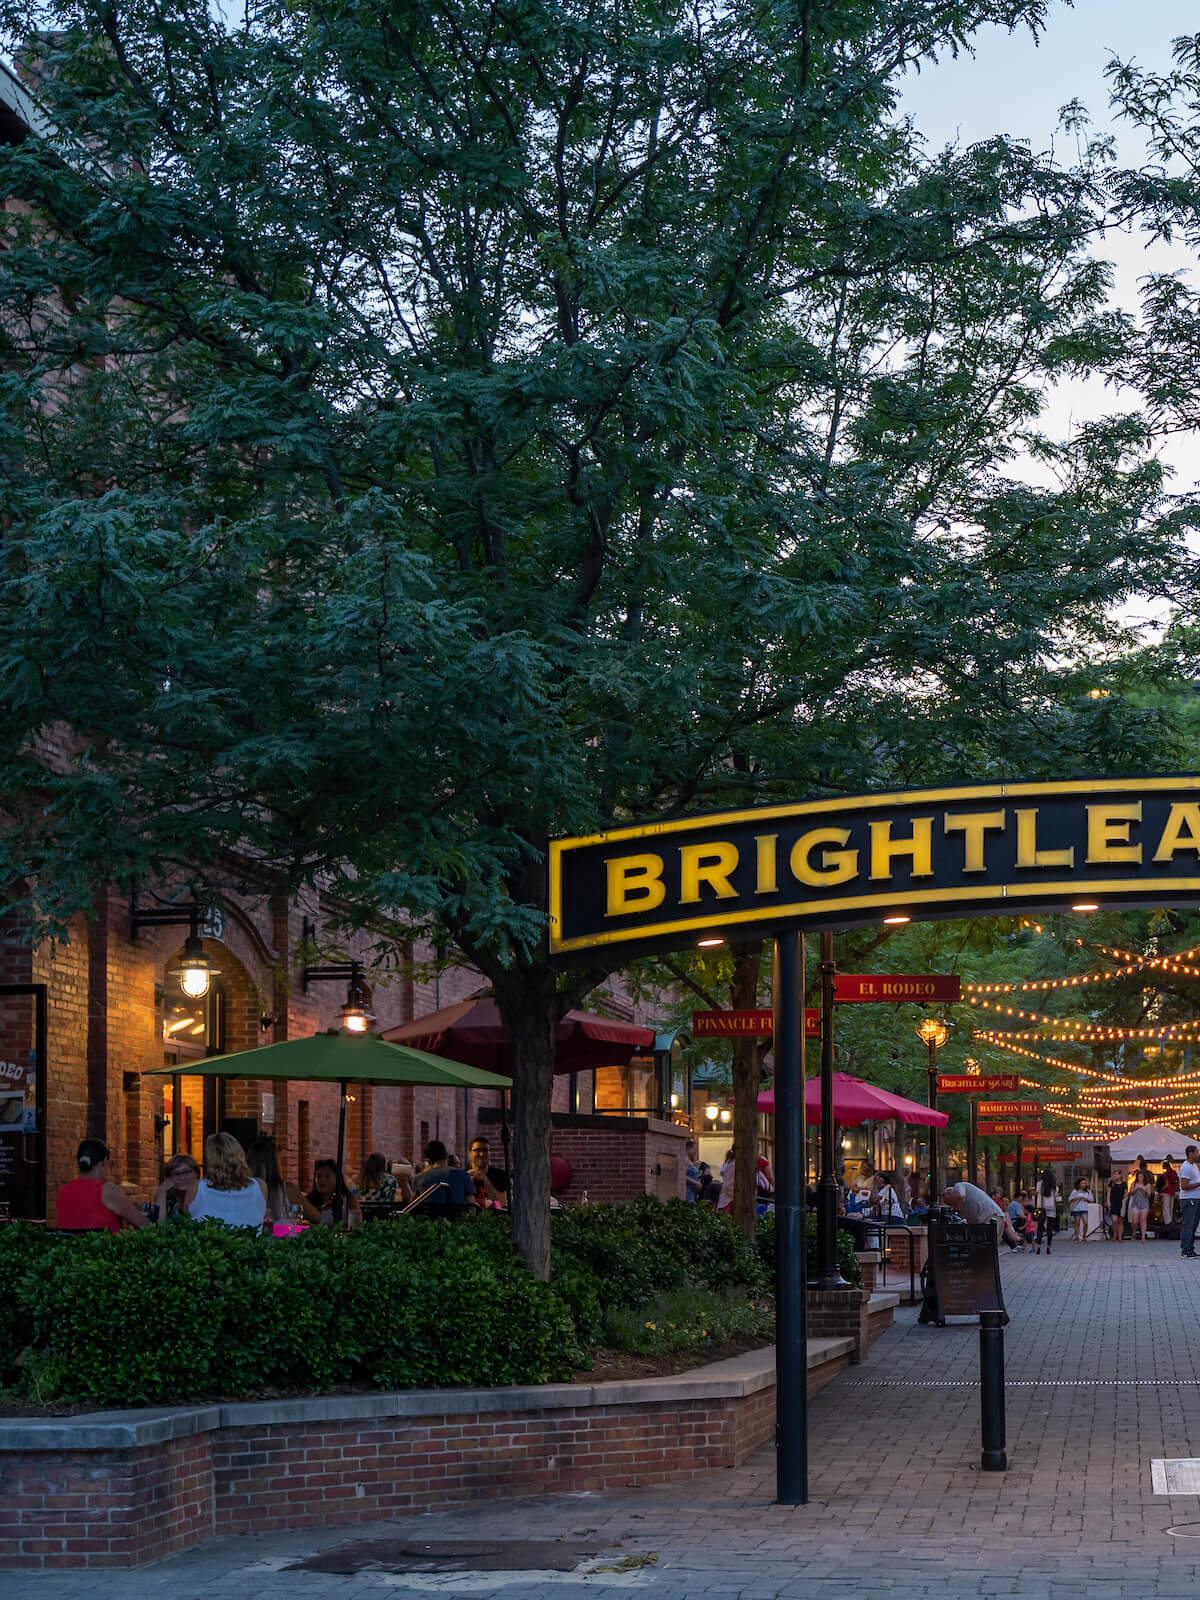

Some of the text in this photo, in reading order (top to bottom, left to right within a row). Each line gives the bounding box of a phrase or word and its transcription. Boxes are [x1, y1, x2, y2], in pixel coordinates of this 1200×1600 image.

[859, 982, 936, 995] EL RODEO
[697, 1017, 757, 1031] PINNACLE
[941, 1078, 1016, 1089] BRIGHTLEAF SQUARE
[979, 1104, 1038, 1113] HAMILTON HILL
